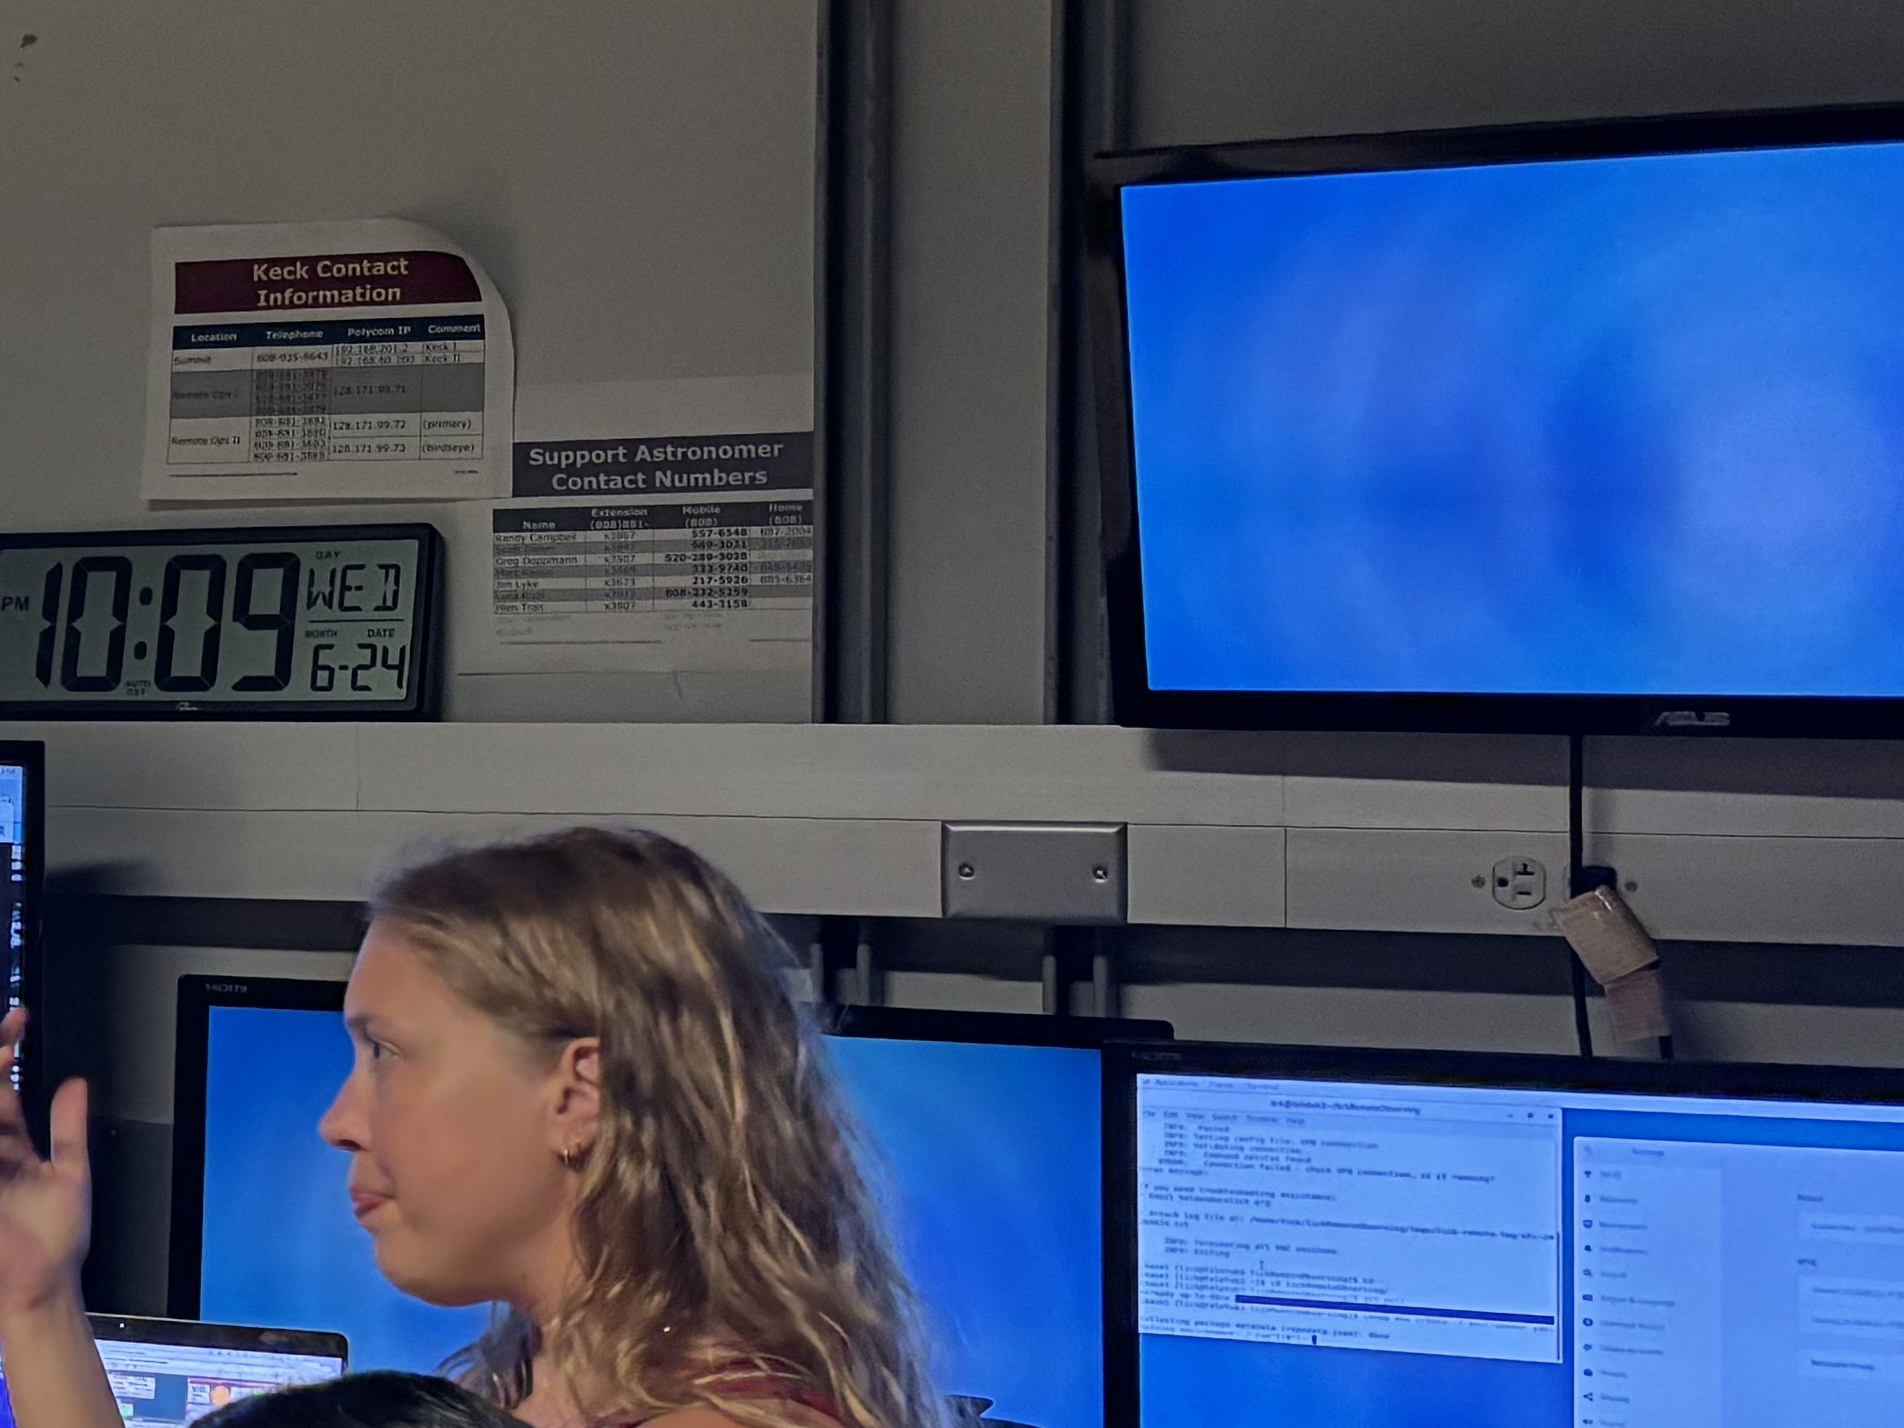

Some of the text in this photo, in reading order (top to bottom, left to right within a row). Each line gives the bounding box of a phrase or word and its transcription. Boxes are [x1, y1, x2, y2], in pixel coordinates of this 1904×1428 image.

[253, 258, 409, 282] Keck Contact
[257, 286, 401, 307] Information
[529, 442, 784, 468] Support Astronomer
[552, 469, 767, 492] Contact Numbers
[1, 552, 400, 692] PM 10:09 WED
[310, 642, 406, 692] 6-24
